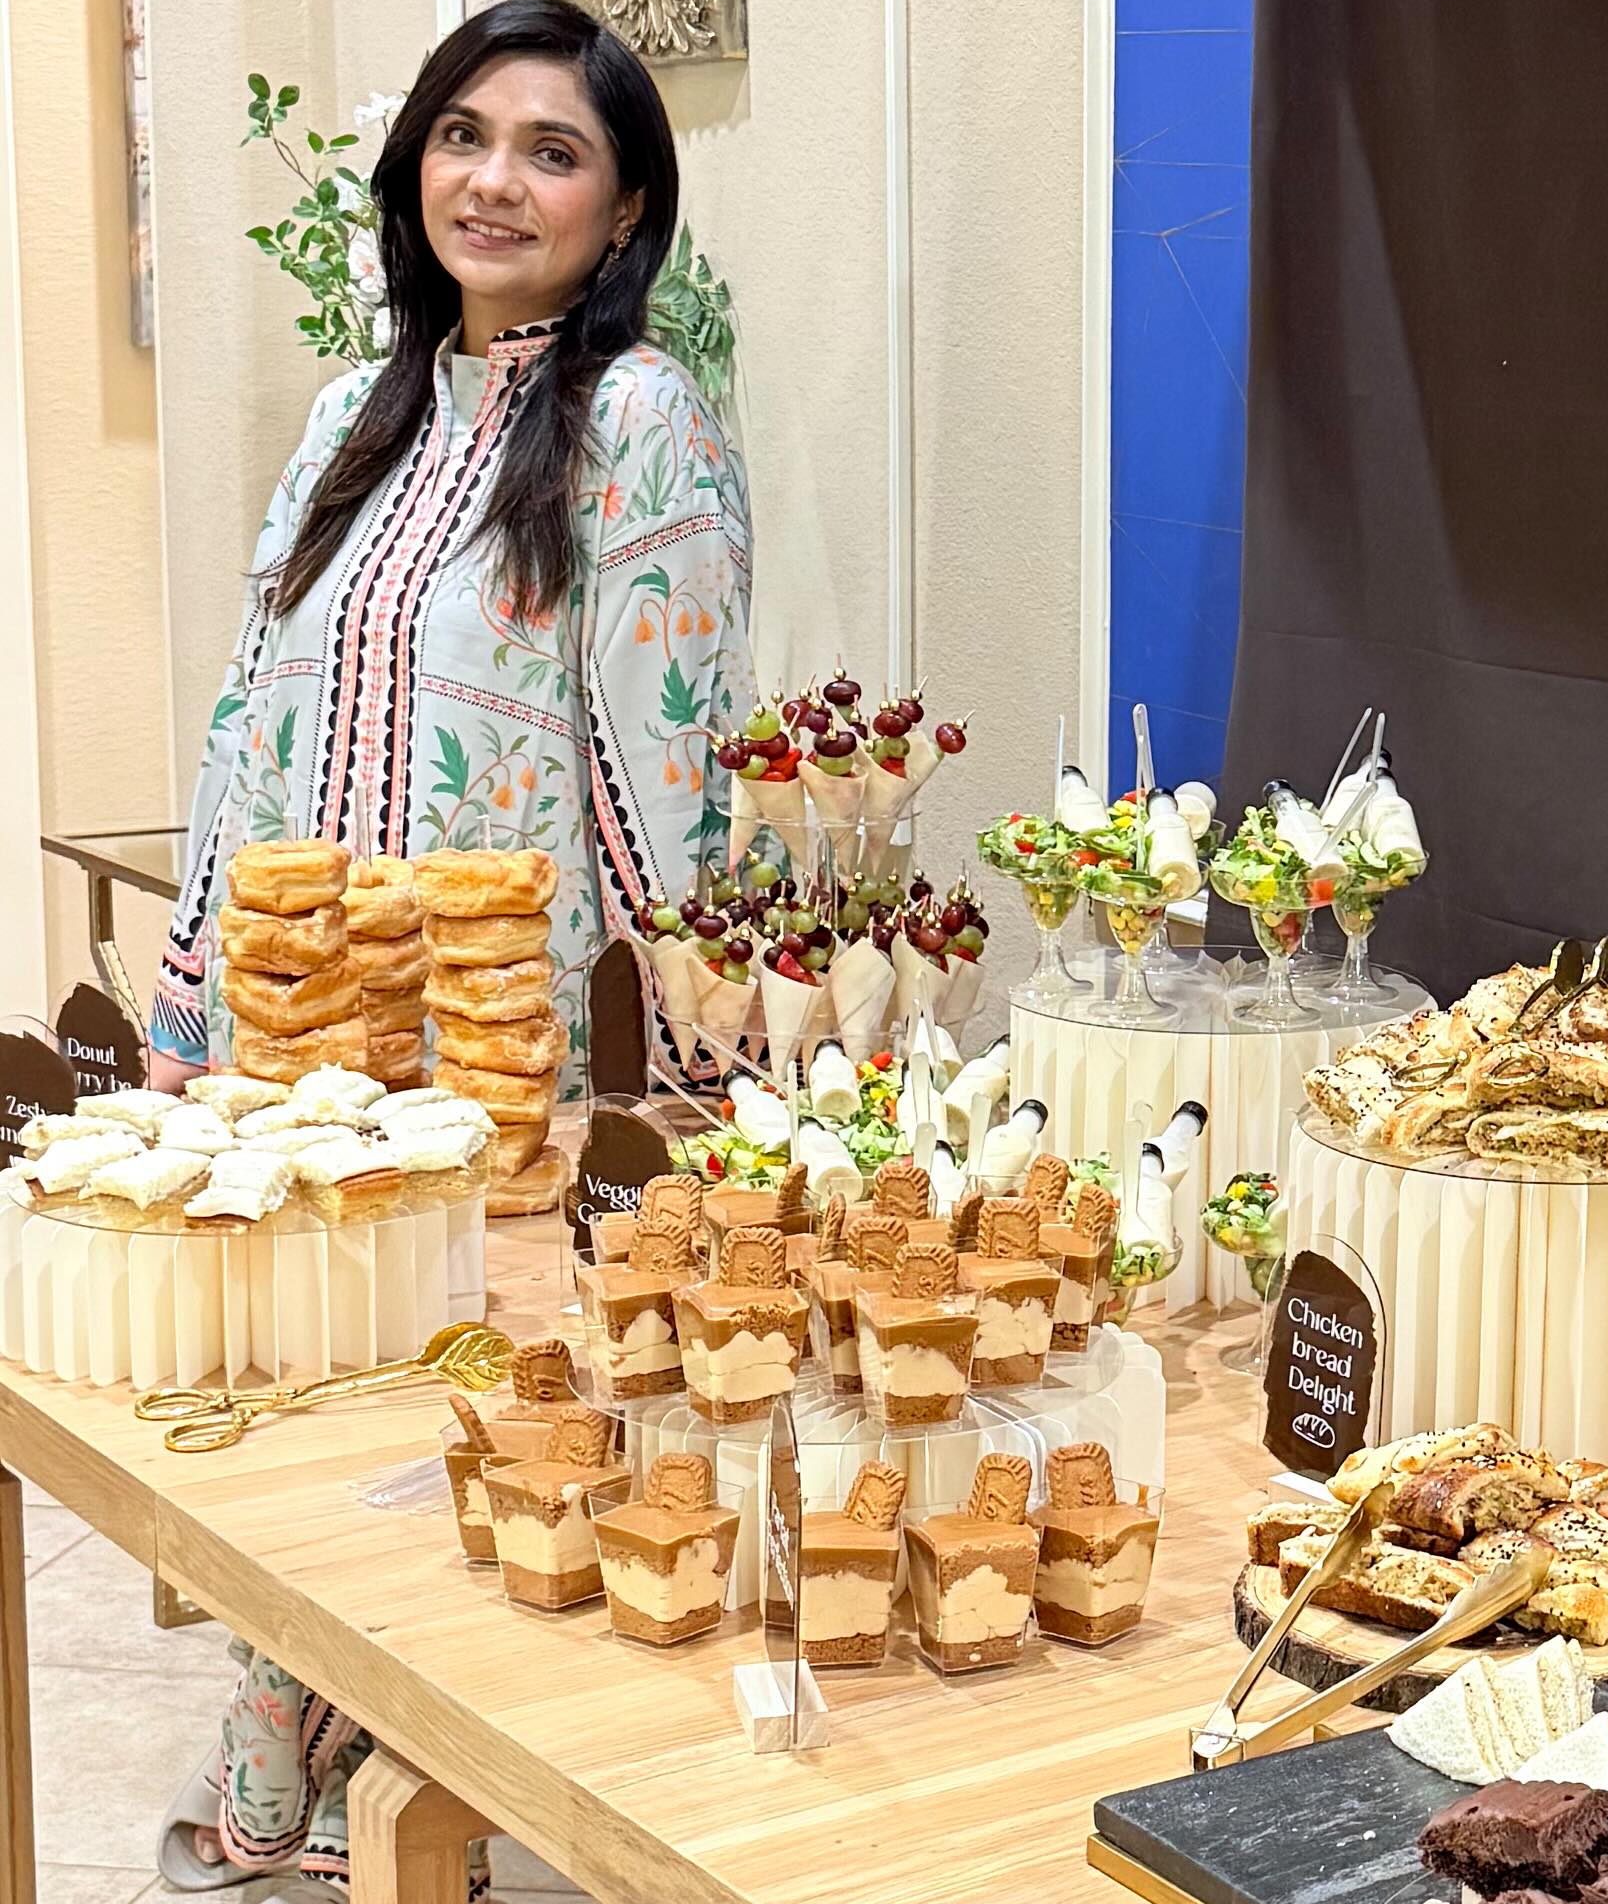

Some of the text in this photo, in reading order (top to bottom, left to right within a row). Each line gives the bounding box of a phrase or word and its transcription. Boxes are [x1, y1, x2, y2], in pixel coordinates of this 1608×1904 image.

[67, 1037, 118, 1066] Donut
[585, 1173, 642, 1212] Veggi
[1287, 1297, 1364, 1349] Chicken
[1291, 1332, 1352, 1379] bread
[1288, 1365, 1357, 1416] Delight
